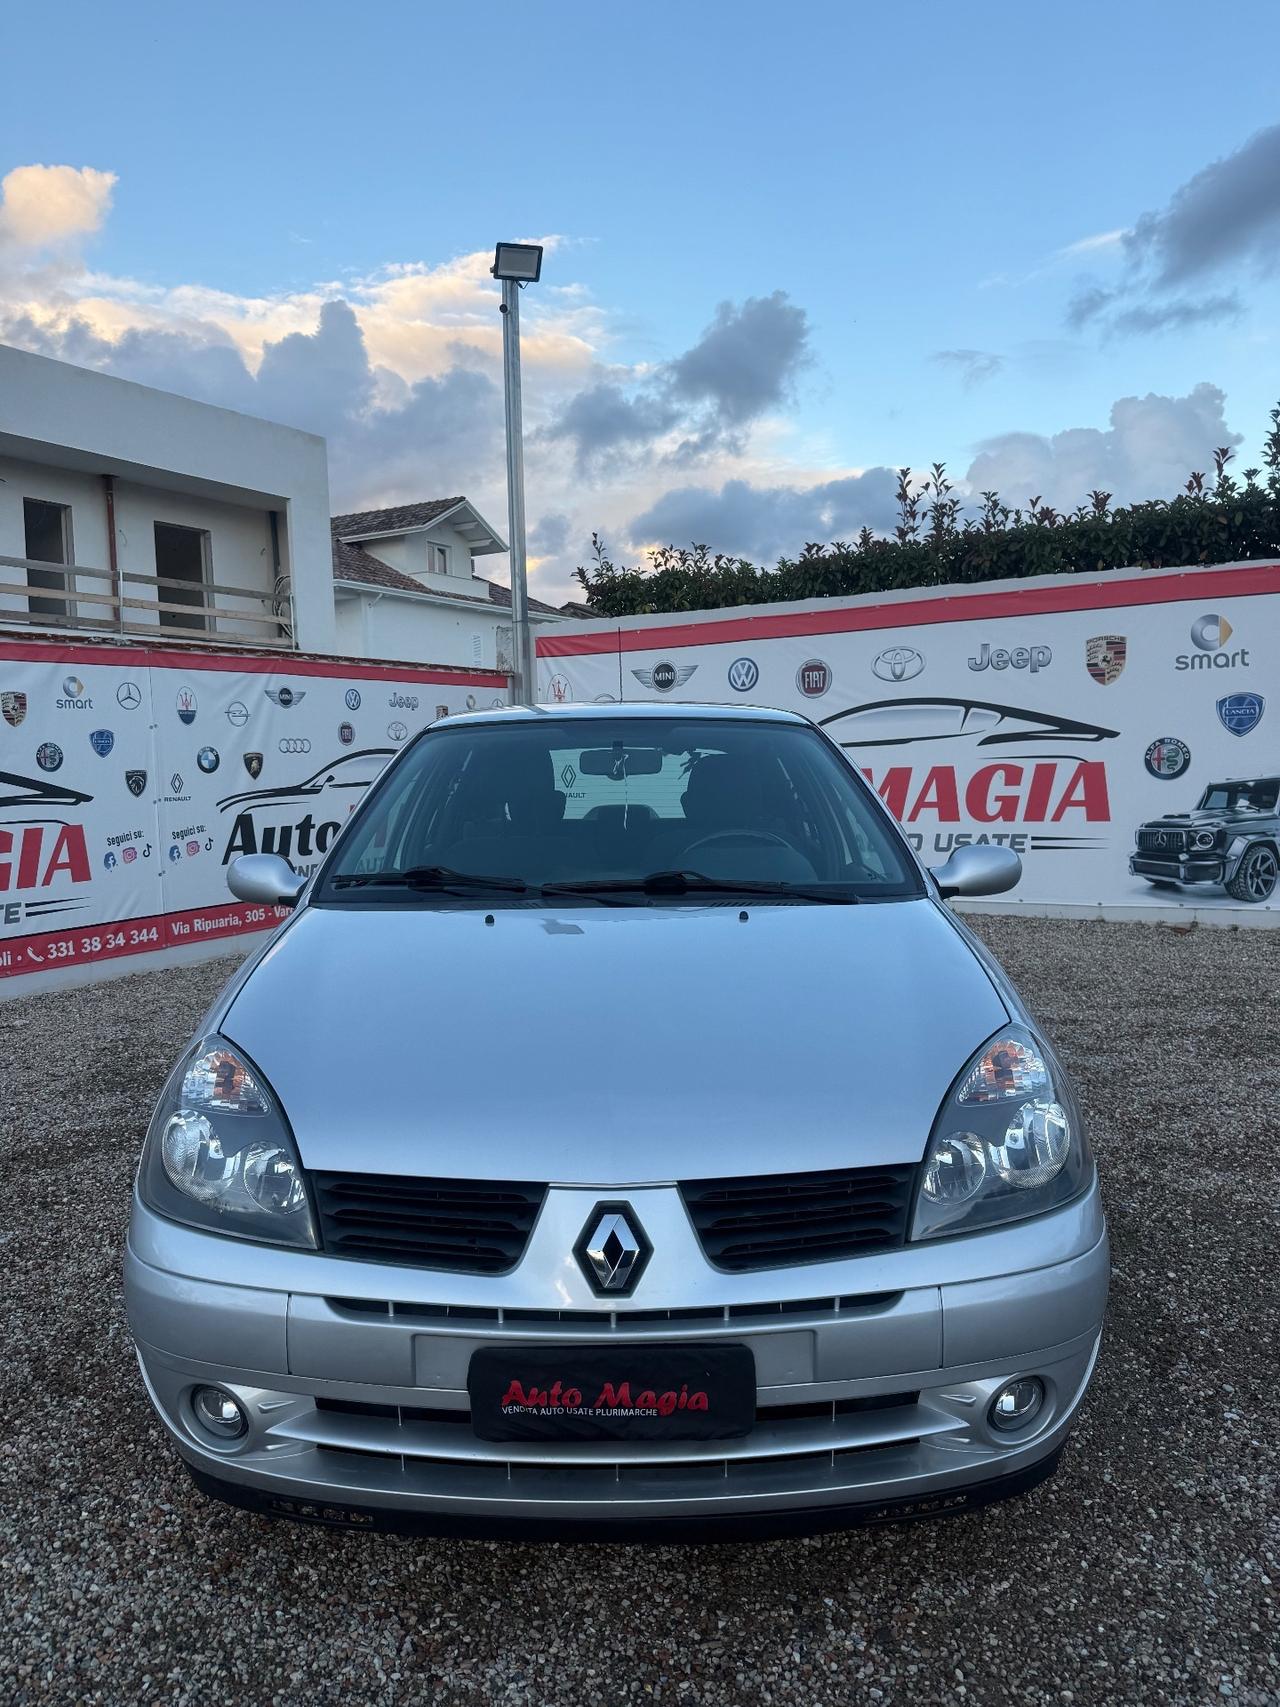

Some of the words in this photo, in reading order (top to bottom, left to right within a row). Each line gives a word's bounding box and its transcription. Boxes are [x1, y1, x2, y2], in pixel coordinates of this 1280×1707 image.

[967, 643, 1052, 673] Jeep
[1175, 649, 1250, 670] smart
[654, 671, 675, 682] MINI
[804, 671, 825, 689] FIAT
[56, 697, 93, 710] smart
[388, 691, 419, 711] Jeep
[1225, 707, 1257, 717] LANCIA
[860, 761, 1111, 823] MAGIA
[106, 832, 132, 847] Seguici
[133, 830, 144, 839] su:
[172, 827, 196, 841] Seguici
[196, 824, 207, 835] su:
[221, 813, 341, 866] Auto
[172, 922, 190, 936] Via
[194, 913, 243, 931] Ripuaria,
[245, 911, 266, 923] 305
[47, 940, 75, 959] 331
[81, 936, 102, 953] 38
[106, 932, 126, 949] 34
[130, 927, 159, 944] 344
[501, 1380, 582, 1407] Auto
[593, 1381, 709, 1417] Magia
[501, 1406, 538, 1415] VENDITA
[540, 1406, 564, 1416] AUTO
[566, 1406, 594, 1416] USATE
[595, 1407, 658, 1417] PLURIMARCHE
